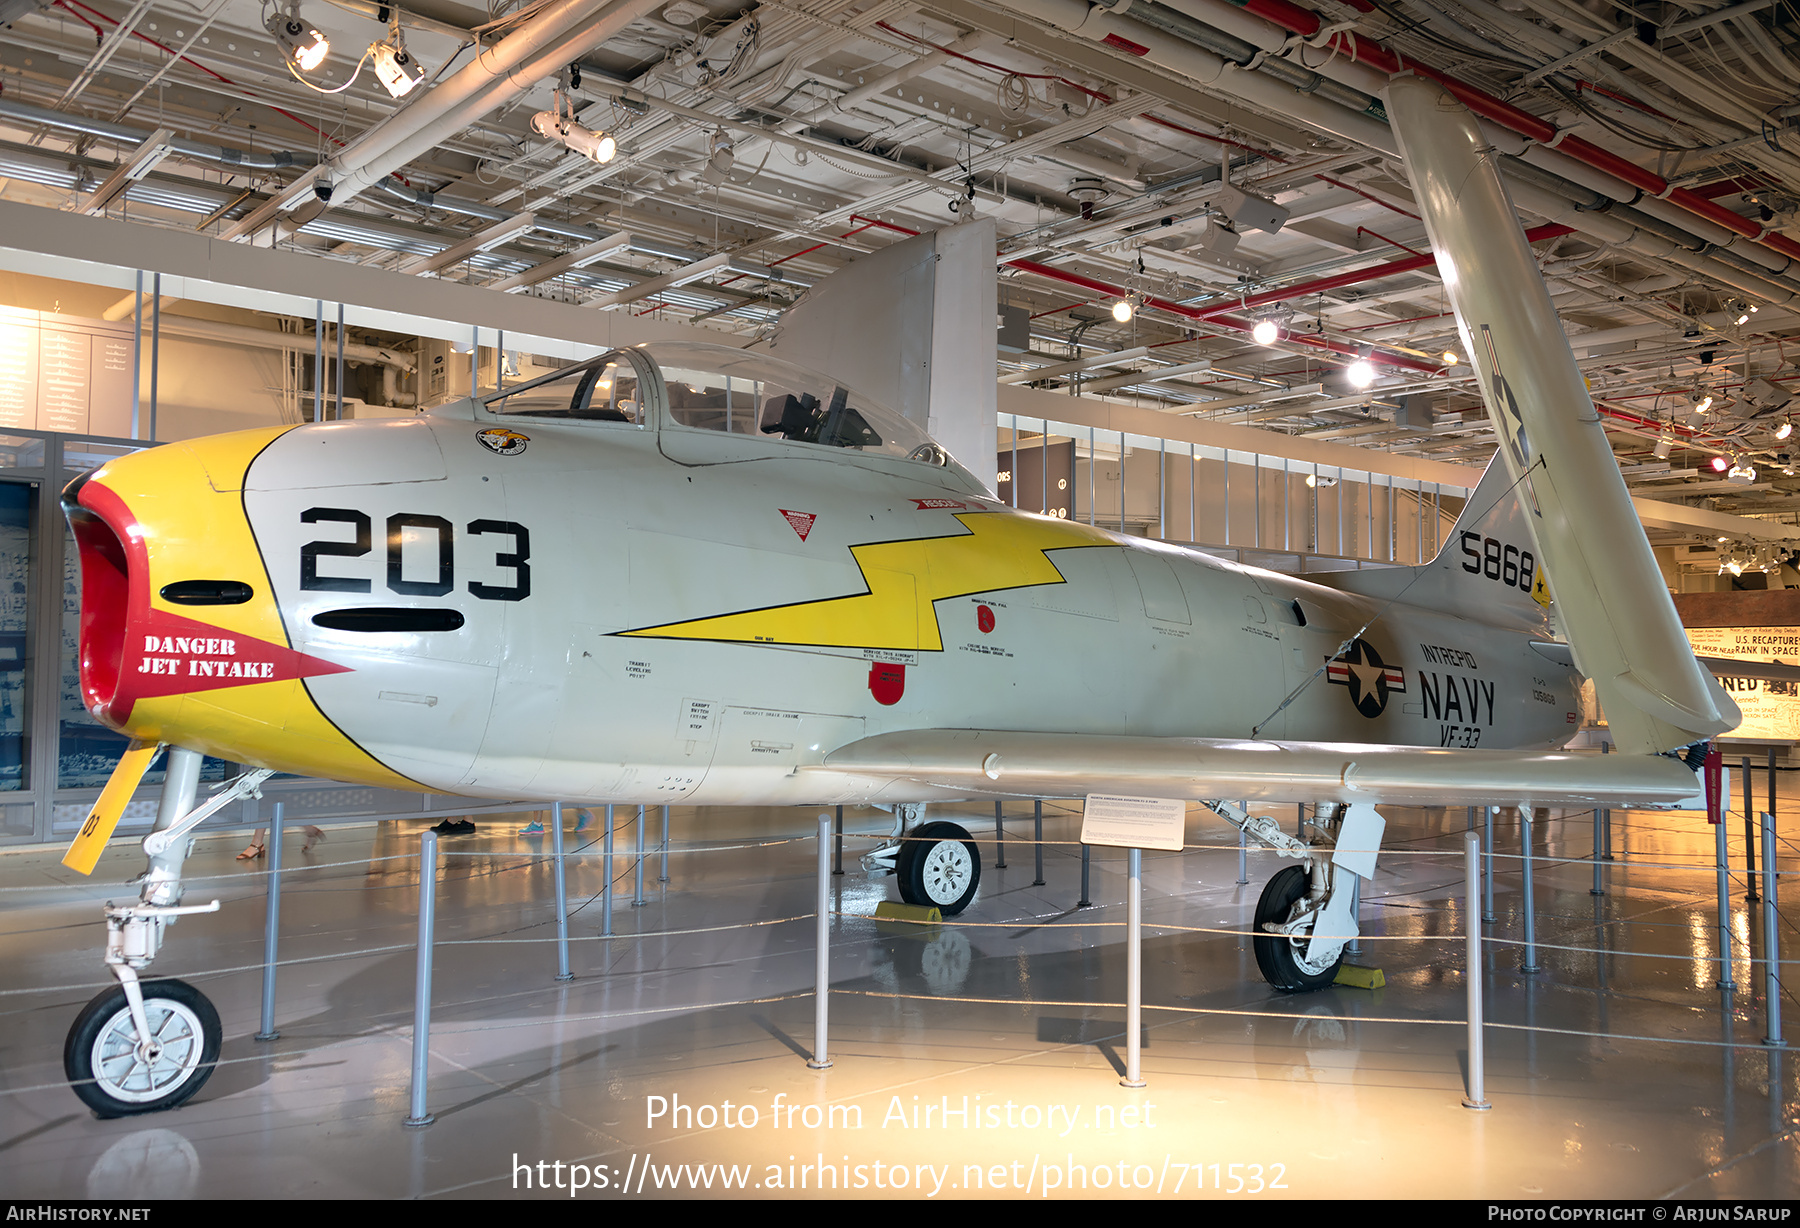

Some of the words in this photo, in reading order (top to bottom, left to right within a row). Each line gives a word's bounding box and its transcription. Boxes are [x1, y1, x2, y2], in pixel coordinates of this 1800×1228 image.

[996, 470, 1011, 482] ORS
[299, 506, 531, 602] 203
[1460, 529, 1534, 593] 5868
[144, 635, 236, 656] DANGER
[1735, 635, 1750, 645] U.S.
[1420, 643, 1477, 669] INTREPID
[1702, 645, 1718, 653] HOUR
[1735, 645, 1758, 655] RANK
[1760, 646, 1769, 655] IN
[1772, 646, 1798, 656] SPACE
[137, 657, 181, 675] JET
[188, 660, 274, 678] INTAKE
[625, 666, 651, 674] LEVELING
[1715, 677, 1757, 692] NED
[1418, 671, 1494, 726] NAVY
[1734, 696, 1759, 704] Kennedy
